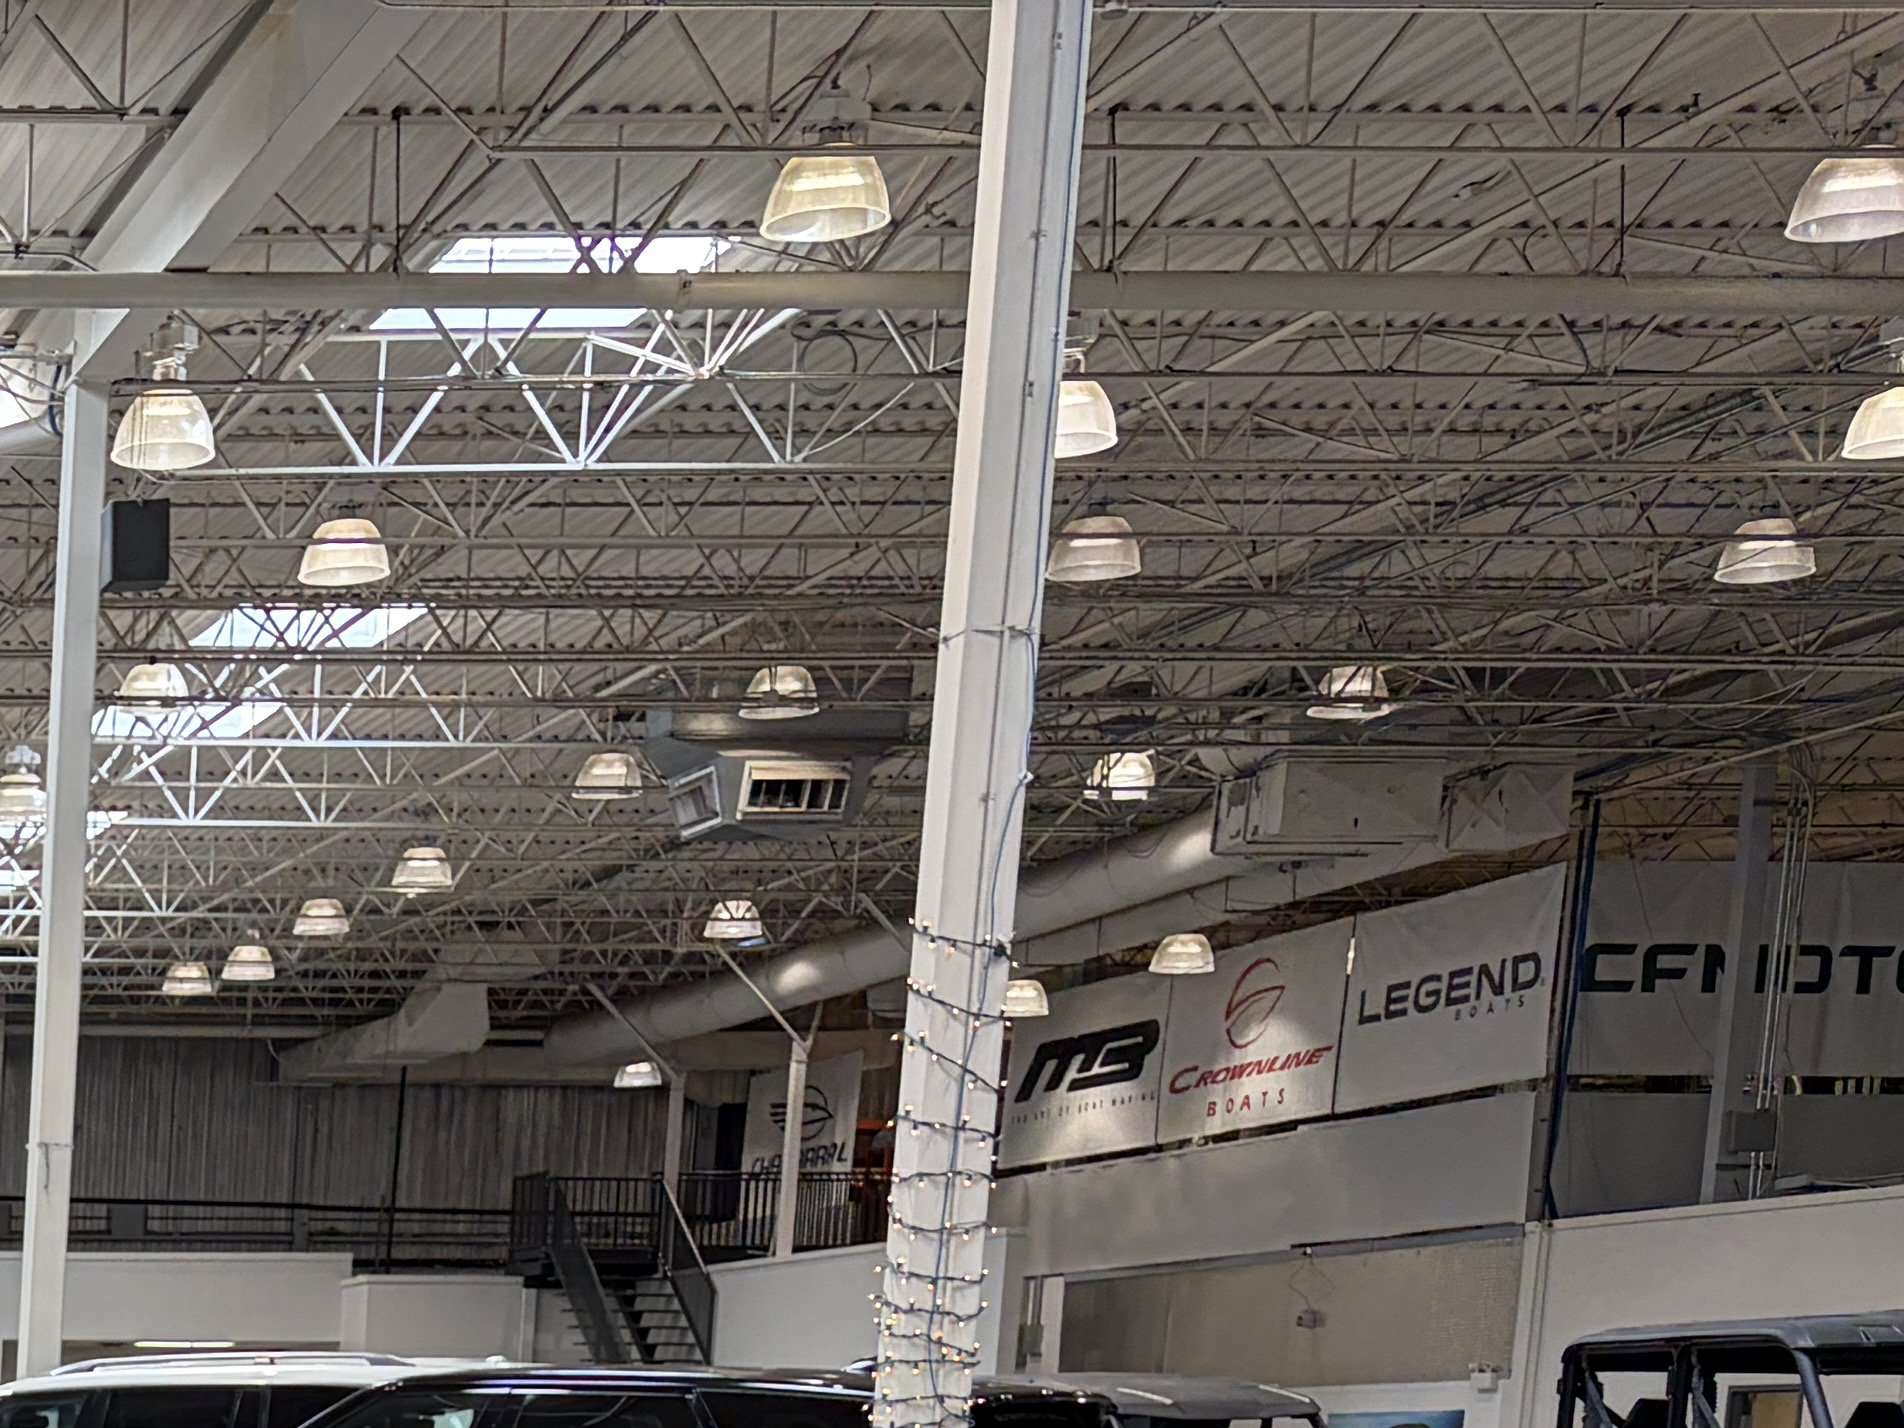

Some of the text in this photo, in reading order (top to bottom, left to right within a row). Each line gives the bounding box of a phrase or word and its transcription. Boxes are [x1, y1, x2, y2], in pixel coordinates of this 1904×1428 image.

[1358, 951, 1542, 1026] LEGEND
[1579, 942, 1904, 995] CFMOT
[1454, 994, 1525, 1021] BOATS
[1206, 1088, 1285, 1117] BOATS
